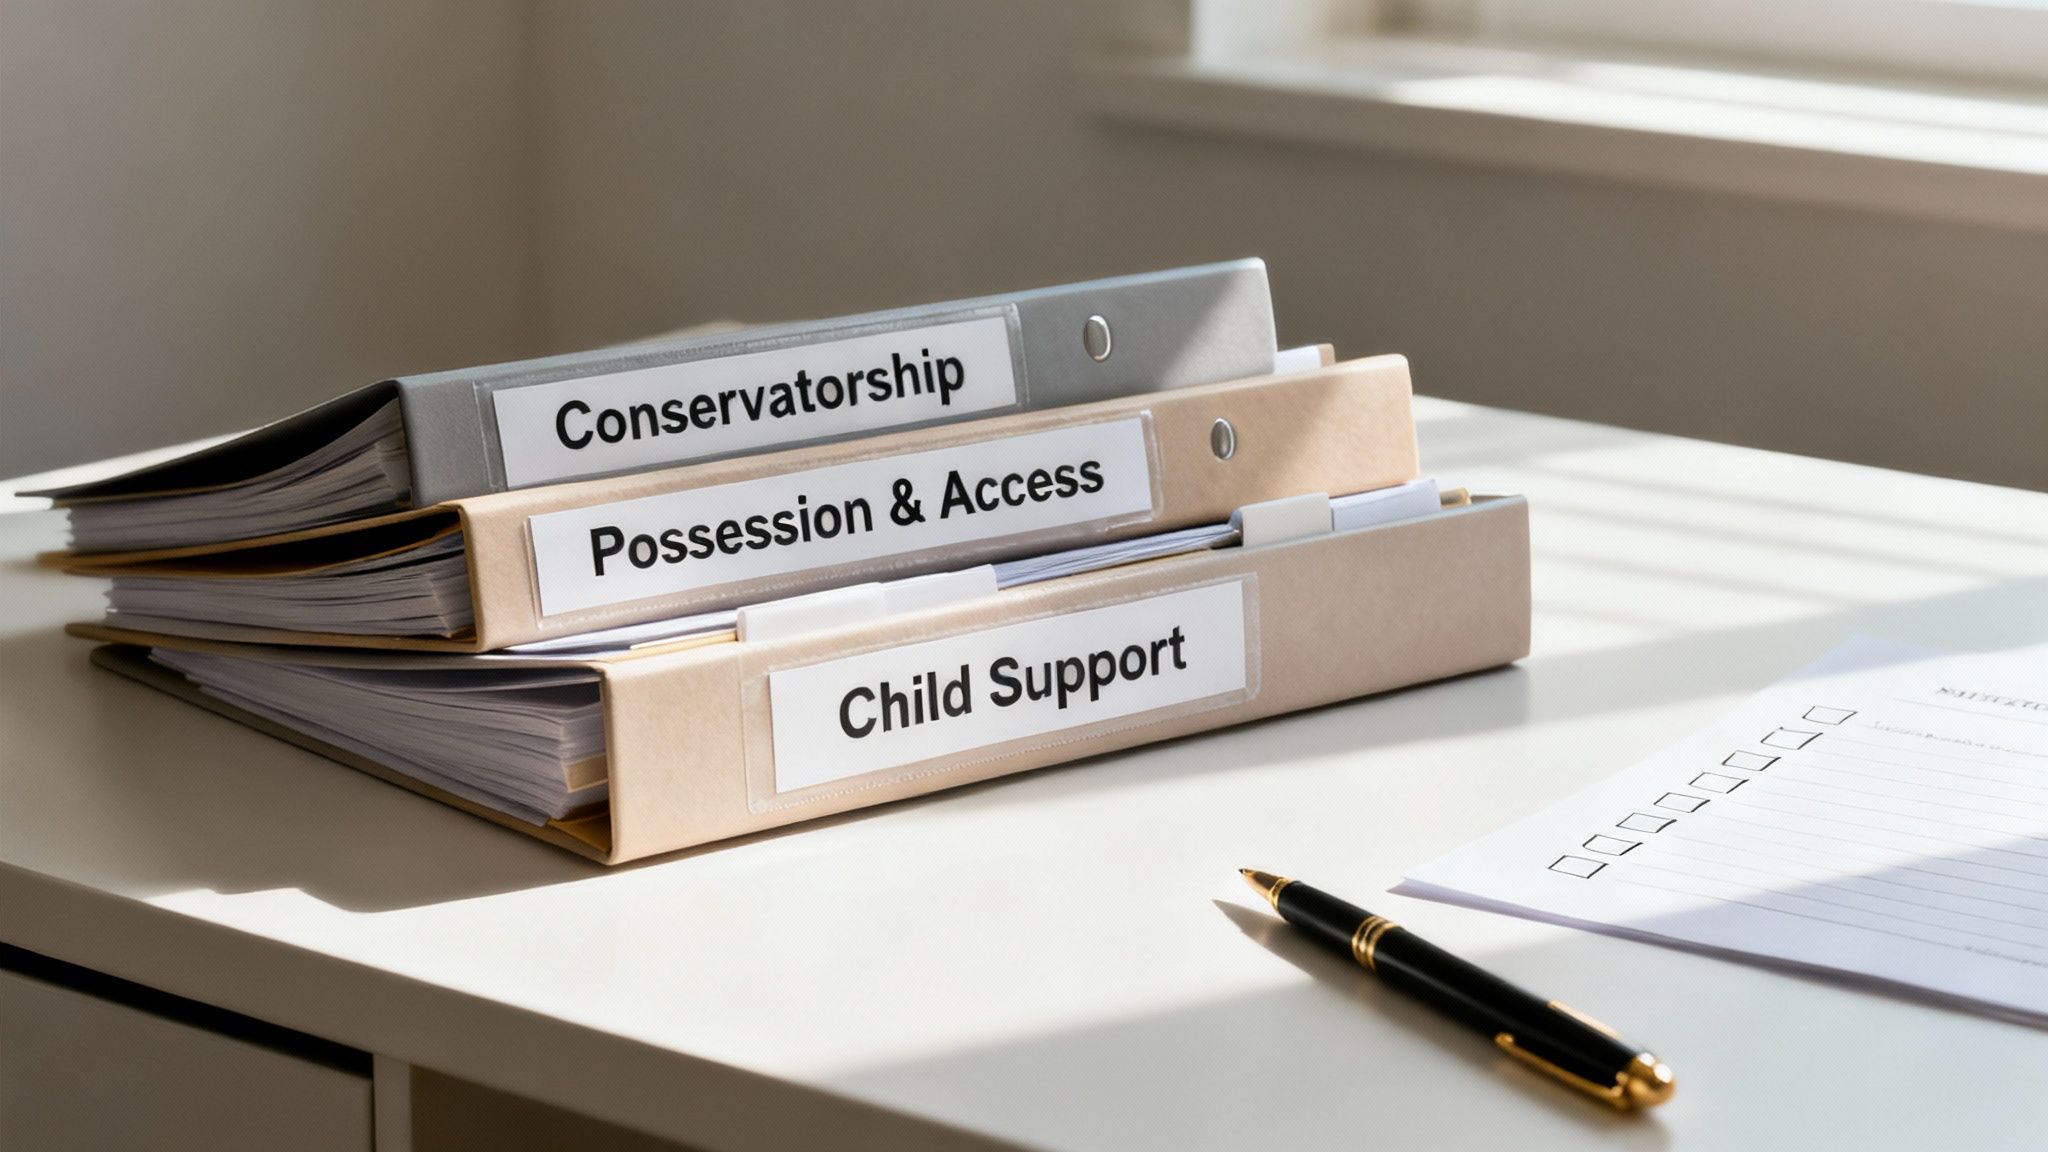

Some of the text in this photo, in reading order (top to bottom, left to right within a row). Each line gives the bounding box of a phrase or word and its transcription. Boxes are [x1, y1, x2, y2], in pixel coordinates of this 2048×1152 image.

[556, 349, 965, 450] Conservatorship
[591, 460, 1104, 577] Possession & Access
[839, 626, 1187, 739] Child Support
